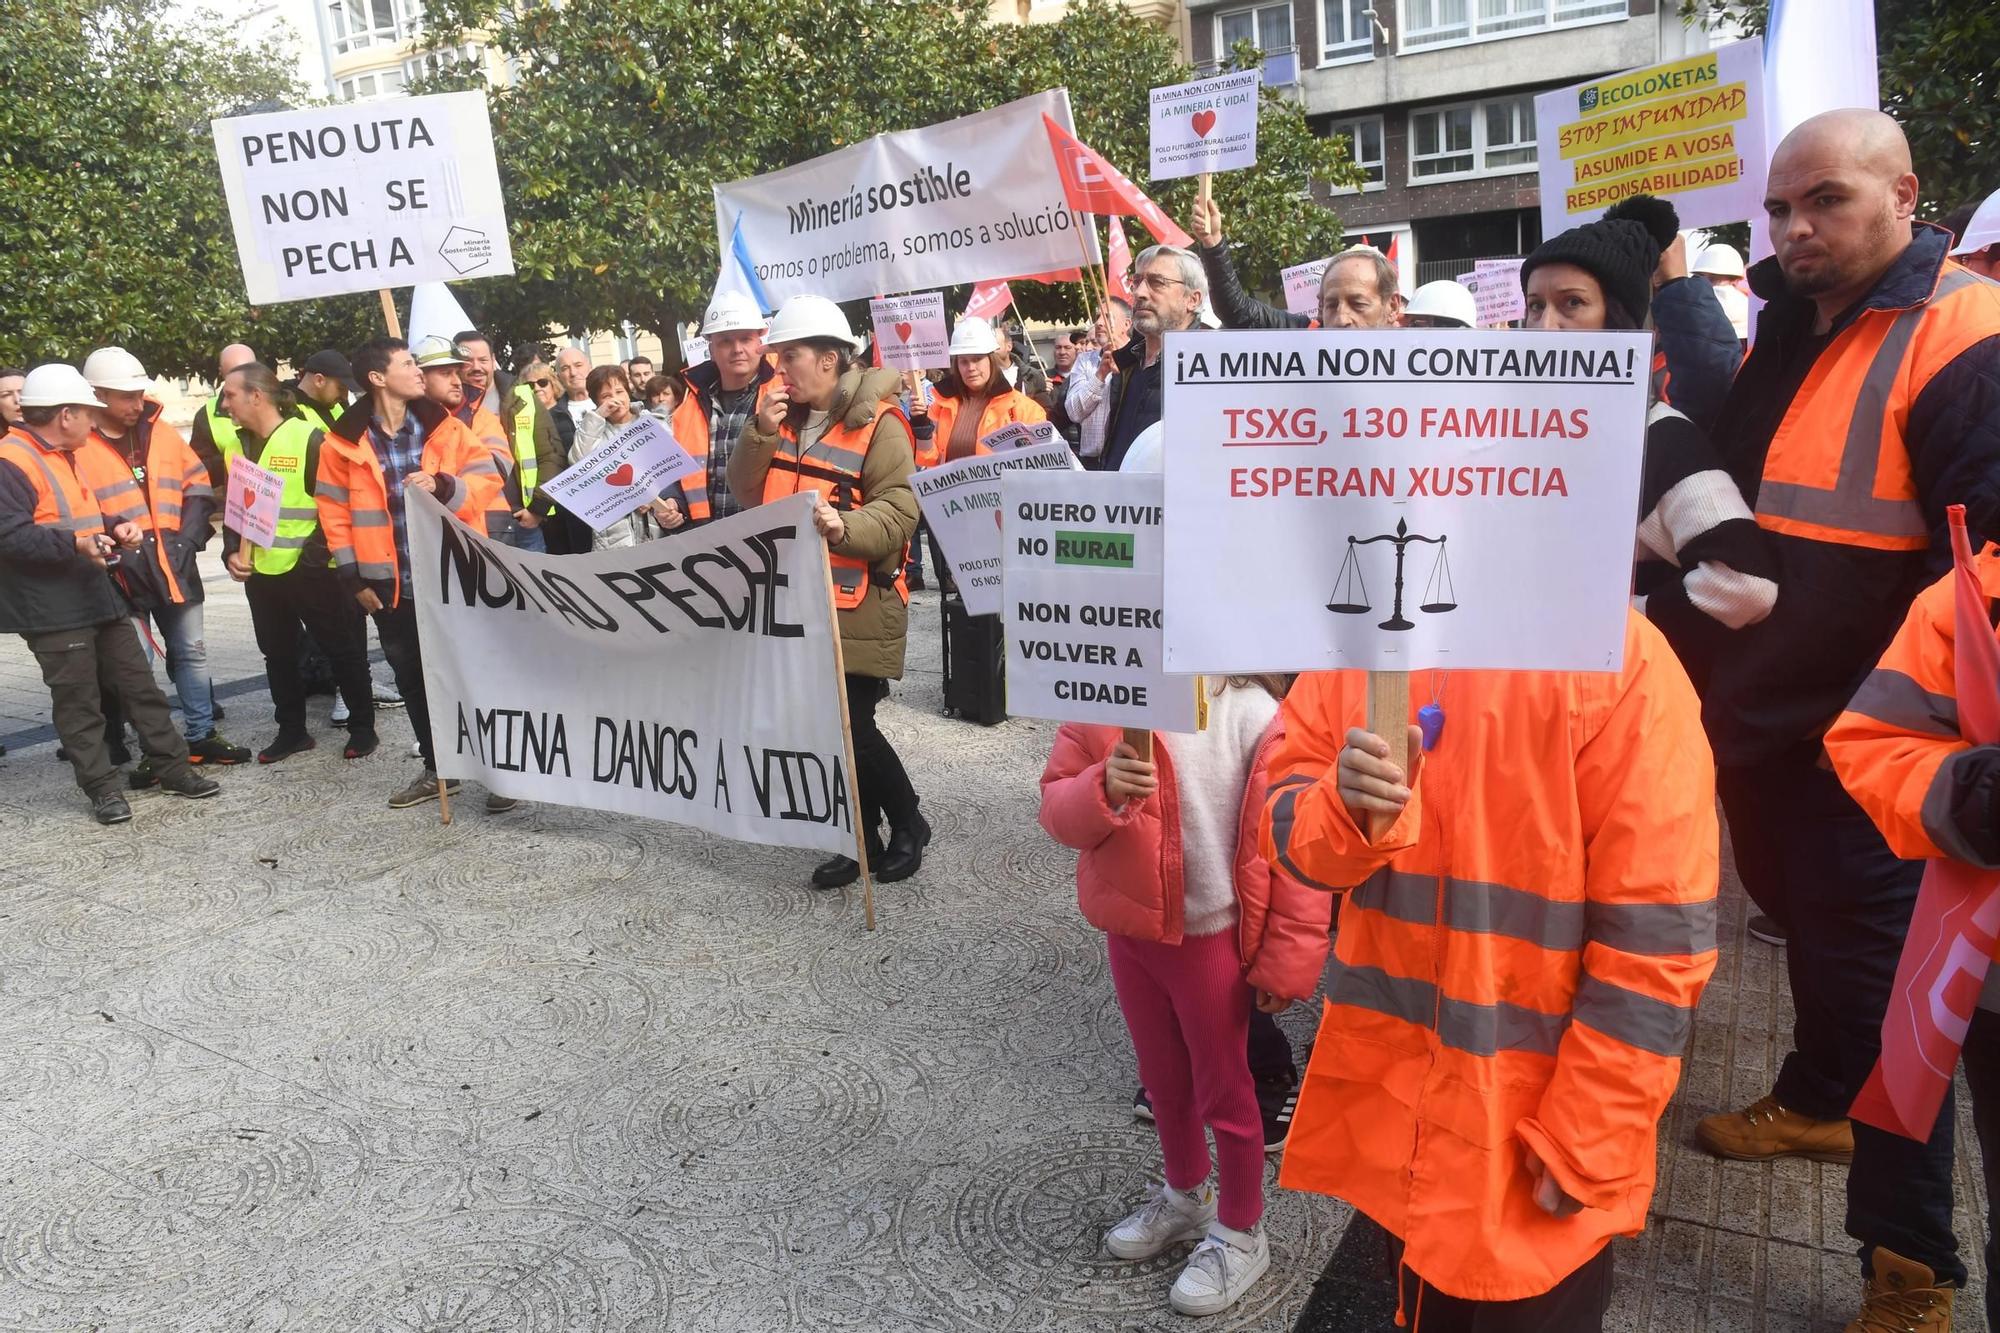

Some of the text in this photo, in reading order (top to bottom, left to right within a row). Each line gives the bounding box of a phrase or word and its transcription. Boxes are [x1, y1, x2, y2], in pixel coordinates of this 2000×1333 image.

[1162, 90, 1182, 100] MINA
[1184, 86, 1202, 96] NON
[1204, 75, 1256, 92] CONTAMINA!
[1601, 63, 1718, 106] ECOLOXETAS
[1174, 100, 1213, 116] MINERIA
[1224, 92, 1249, 107] VIDA!
[1560, 88, 1746, 149] STOP IMPUNIDAD
[1155, 145, 1171, 154] POLO
[1172, 140, 1195, 152] FUTURO
[1195, 140, 1204, 148] DO
[1204, 138, 1224, 147] RURAL
[1225, 133, 1246, 143] GALEGO
[1159, 156, 1168, 164] OS
[1168, 154, 1189, 162] NOSOS
[1210, 148, 1218, 156] DE
[1220, 144, 1247, 154] TRABALLO
[1575, 132, 1734, 182] ¡ASUMIDE A VOSA
[786, 161, 972, 235] Minería sostible
[1566, 158, 1745, 210] RESPONSABILIDADE!
[261, 178, 428, 225] NON SE
[753, 256, 804, 282] somos
[808, 259, 818, 276] o
[822, 237, 896, 280] problema,
[903, 226, 974, 258] somos
[980, 223, 992, 245] a
[1304, 278, 1320, 288] MIN
[900, 296, 940, 308] CONTAMINA!
[915, 309, 936, 320] VIDA!
[1177, 348, 1636, 382] ¡A MINA NON CONTAMINA!
[996, 427, 1022, 441] MINA
[1223, 407, 1590, 443] TSXG, 130 FAMILIAS
[557, 472, 580, 488] MINA
[580, 458, 599, 474] NON
[598, 419, 654, 459] CONTAMINA!
[578, 460, 622, 490] MINERIA
[626, 432, 658, 453] VIDA!
[600, 490, 626, 507] FUTURO
[626, 485, 636, 496] DO
[634, 470, 653, 490] RURAL
[651, 455, 676, 472] GALEGO
[604, 499, 625, 514] NOSOS
[646, 479, 654, 488] DE
[652, 462, 684, 480] TRABALLO
[933, 469, 968, 490] MINA
[969, 466, 992, 480] NON
[1230, 467, 1569, 498] ESPERAN XUSTICIA
[964, 492, 1002, 510] MINER
[1018, 502, 1096, 523] QUERO
[1018, 537, 1134, 562] NO RURAL
[958, 560, 982, 572] POLO
[518, 562, 620, 633] AO
[593, 525, 805, 638] PECHE
[971, 574, 1000, 588] OS NOS
[1018, 602, 1071, 624] NON
[1018, 640, 1144, 668] VOLVER A
[1054, 680, 1148, 707] CIDADE
[456, 701, 852, 834] A MINA DANOS A VIDA
